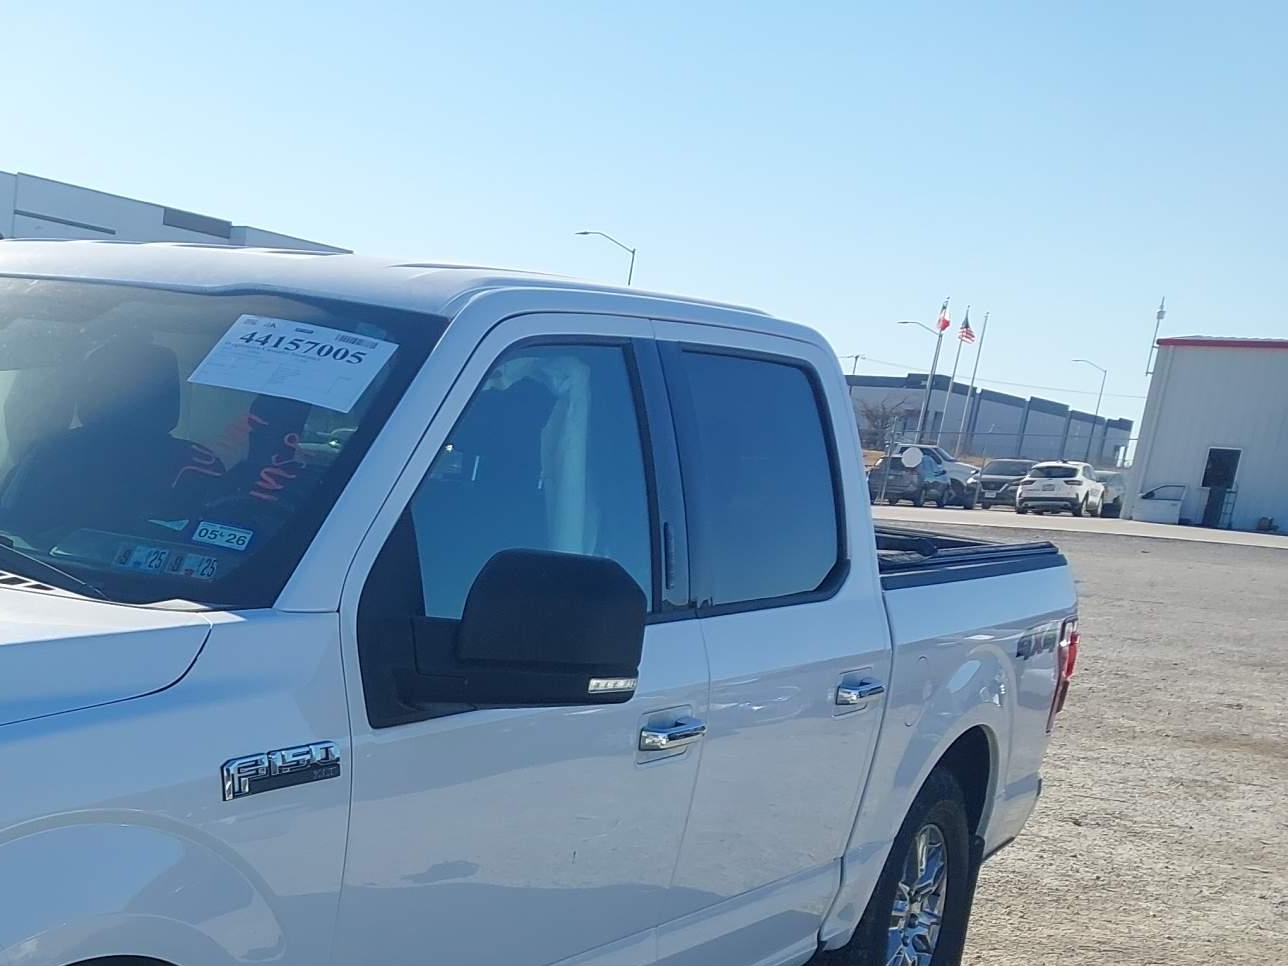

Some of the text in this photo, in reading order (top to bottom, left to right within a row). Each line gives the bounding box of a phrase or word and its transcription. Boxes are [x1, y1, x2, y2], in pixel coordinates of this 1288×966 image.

[240, 331, 367, 364] 44157005
[198, 527, 219, 540] 05
[225, 533, 248, 546] 26
